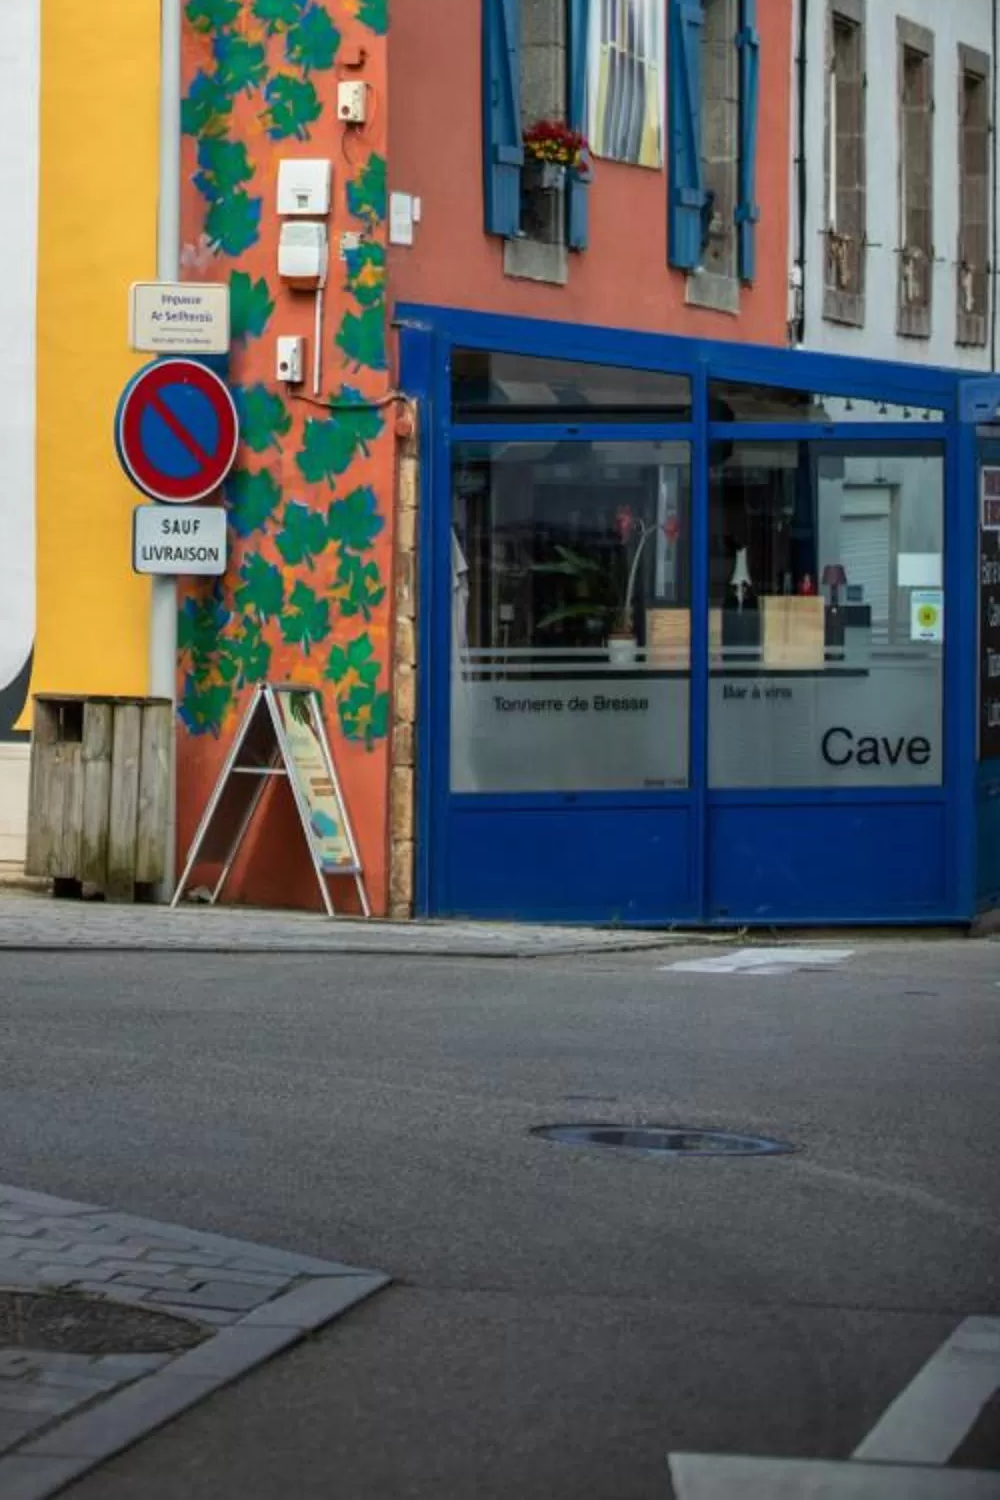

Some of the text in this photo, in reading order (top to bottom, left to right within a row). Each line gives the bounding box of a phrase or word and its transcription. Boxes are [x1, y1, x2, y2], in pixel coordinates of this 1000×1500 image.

[161, 519, 201, 535] SAUF
[142, 546, 219, 561] LIVRAISON
[723, 683, 748, 699] Bar
[763, 684, 793, 699] vins
[493, 696, 564, 713] Tonnerre
[567, 696, 589, 712] de
[821, 726, 932, 766] Cave
